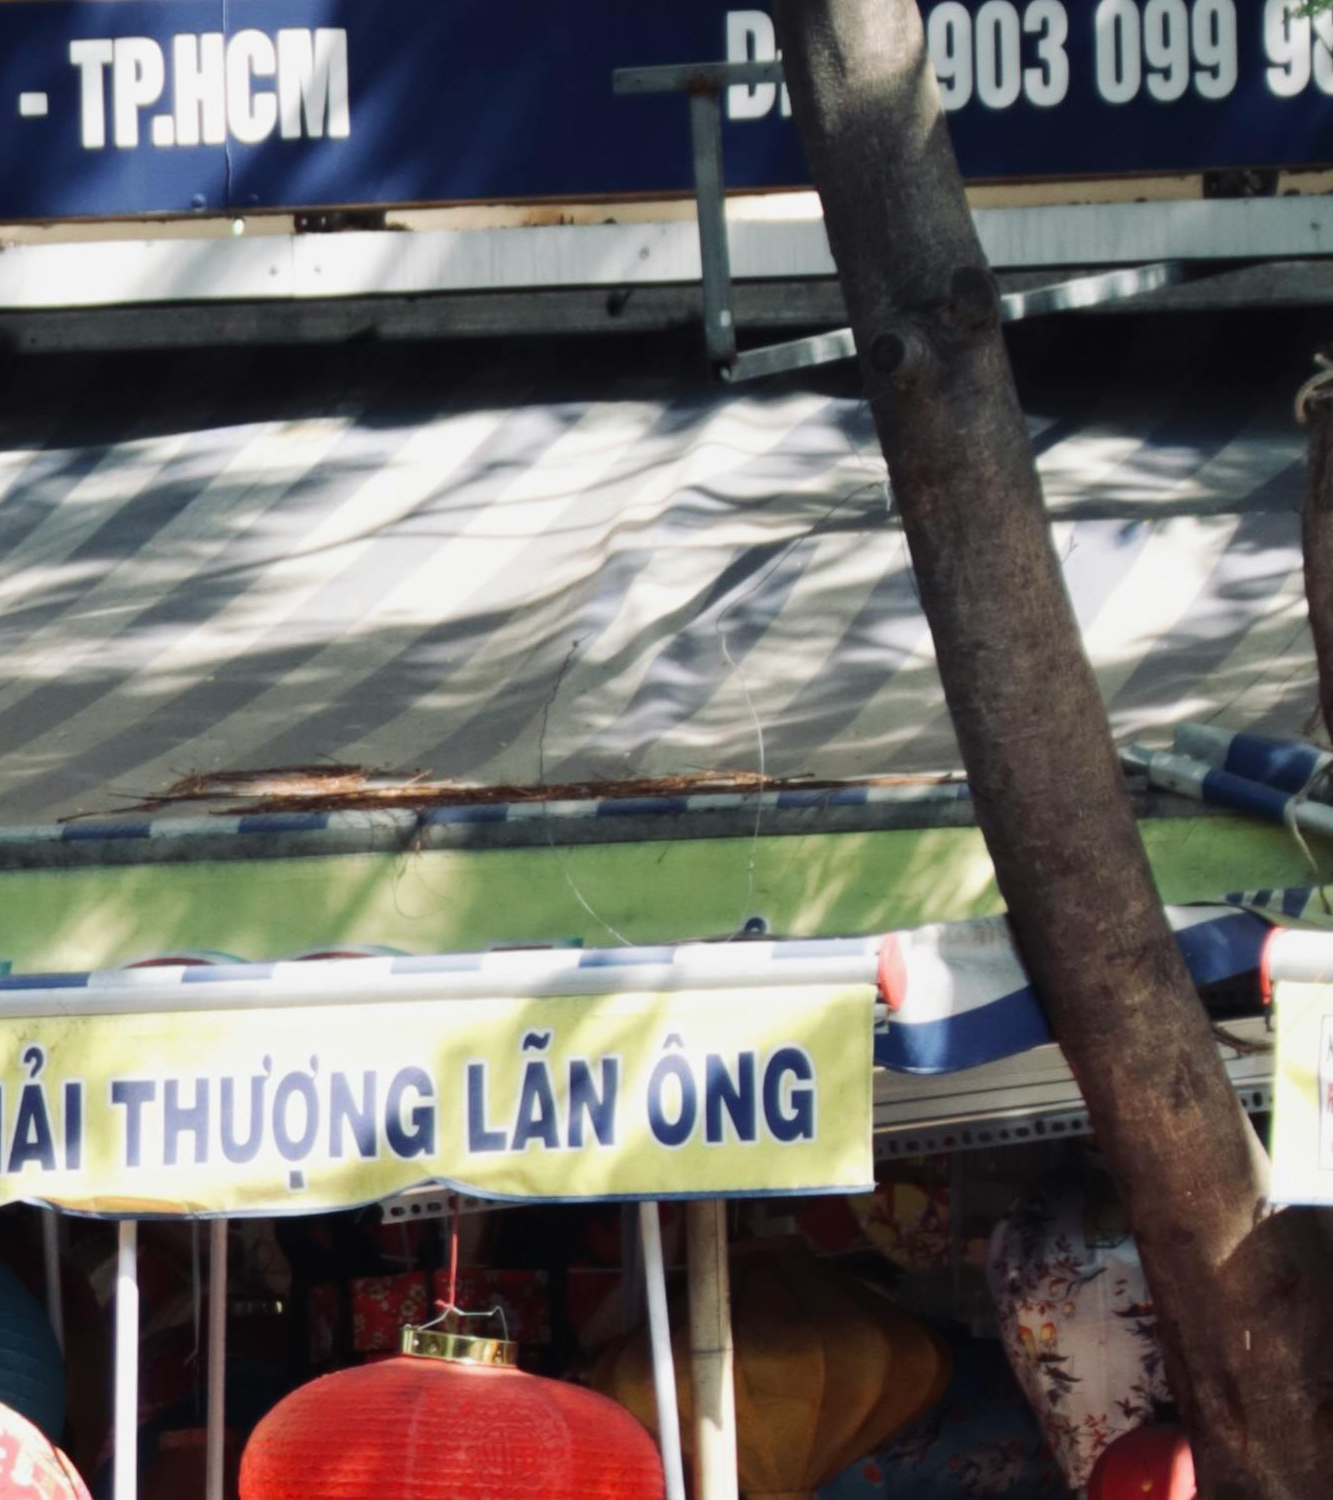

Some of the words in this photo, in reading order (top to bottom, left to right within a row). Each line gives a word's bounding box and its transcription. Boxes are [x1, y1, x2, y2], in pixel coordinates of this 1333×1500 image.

[70, 25, 352, 149] TP.HCM
[109, 1056, 439, 1192] THƯỢNG
[463, 1031, 621, 1158] LÃN
[644, 1034, 817, 1153] ÔNG
